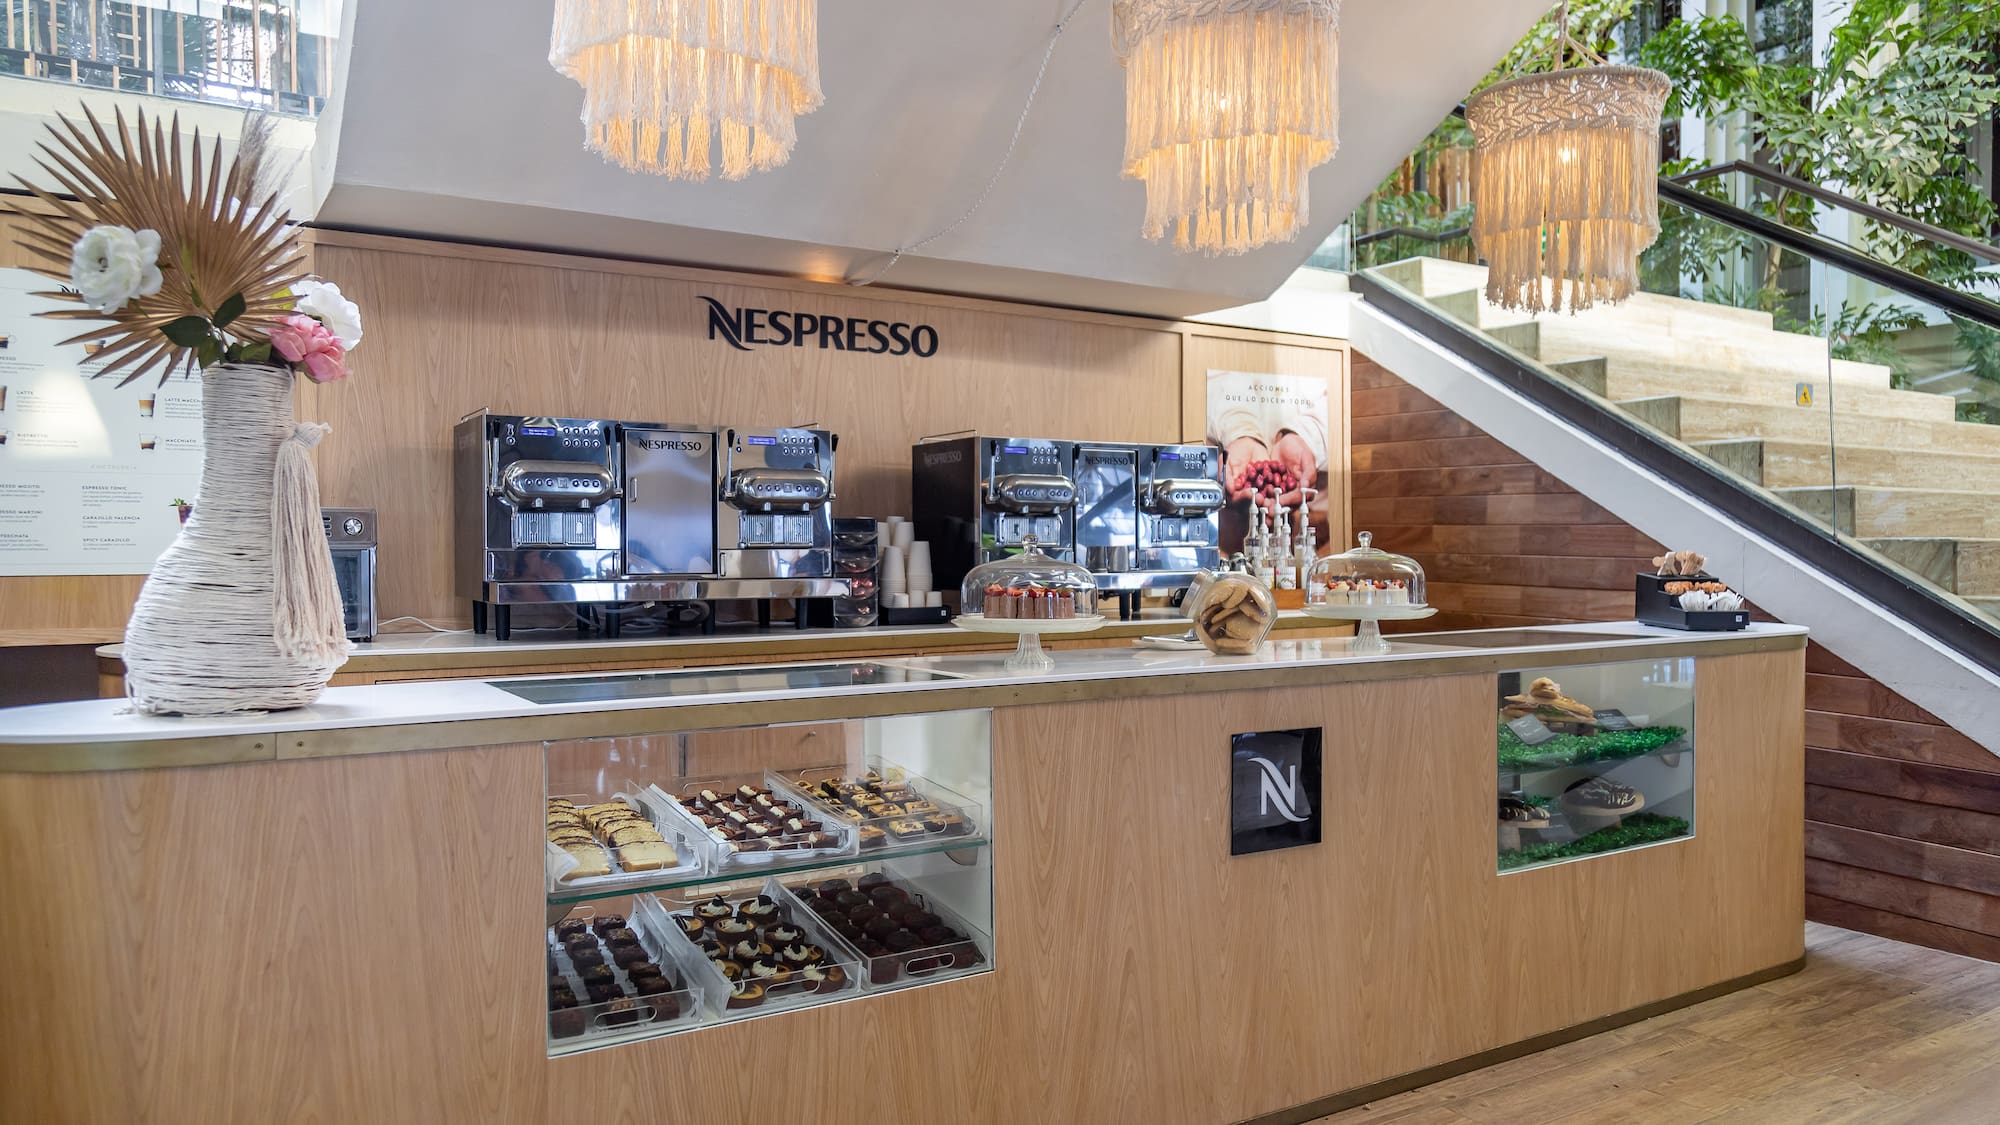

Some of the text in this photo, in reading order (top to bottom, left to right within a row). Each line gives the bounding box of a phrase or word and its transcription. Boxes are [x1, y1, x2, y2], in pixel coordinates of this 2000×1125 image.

[696, 295, 939, 357] NESPRESSO
[1248, 384, 1289, 393] ACCIONES
[1225, 394, 1242, 402] QUE
[1246, 395, 1257, 403] LO
[1260, 396, 1286, 404] DICEN
[638, 437, 702, 451] NESPRESSO
[1084, 454, 1129, 466] NESPRESSO
[1247, 756, 1310, 823] N
